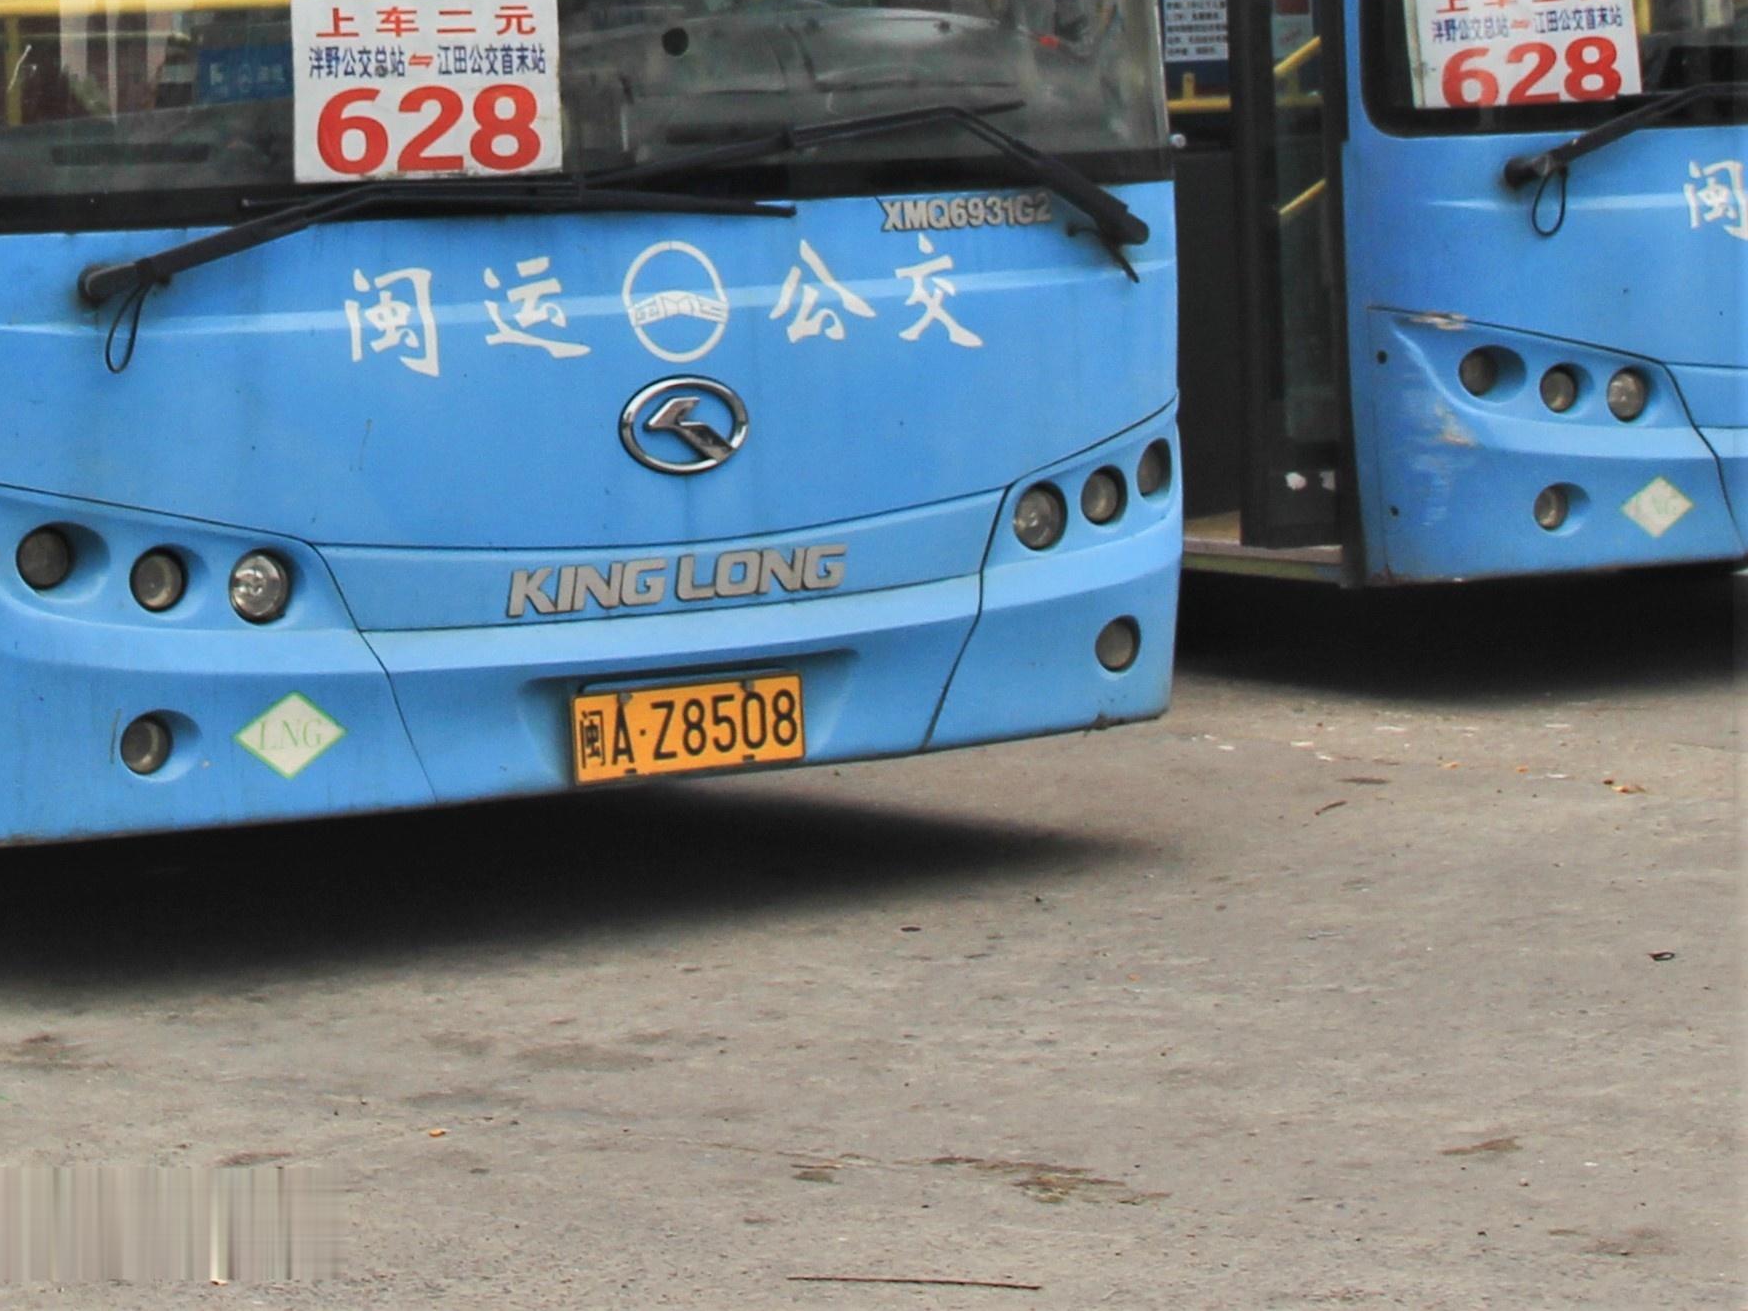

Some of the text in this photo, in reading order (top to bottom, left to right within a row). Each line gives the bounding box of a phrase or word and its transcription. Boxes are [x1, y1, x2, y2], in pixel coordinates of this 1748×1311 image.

[316, 6, 537, 39] 上车二元
[309, 45, 406, 79] 洋野公交总站
[437, 43, 547, 76] 江田公交首末站
[1441, 36, 1623, 108] 628
[317, 84, 542, 176] 628
[881, 193, 1052, 232] XMQ6931G2
[1683, 160, 1748, 241] 闽
[506, 544, 848, 619] KING LONG
[258, 718, 322, 751] LNG
